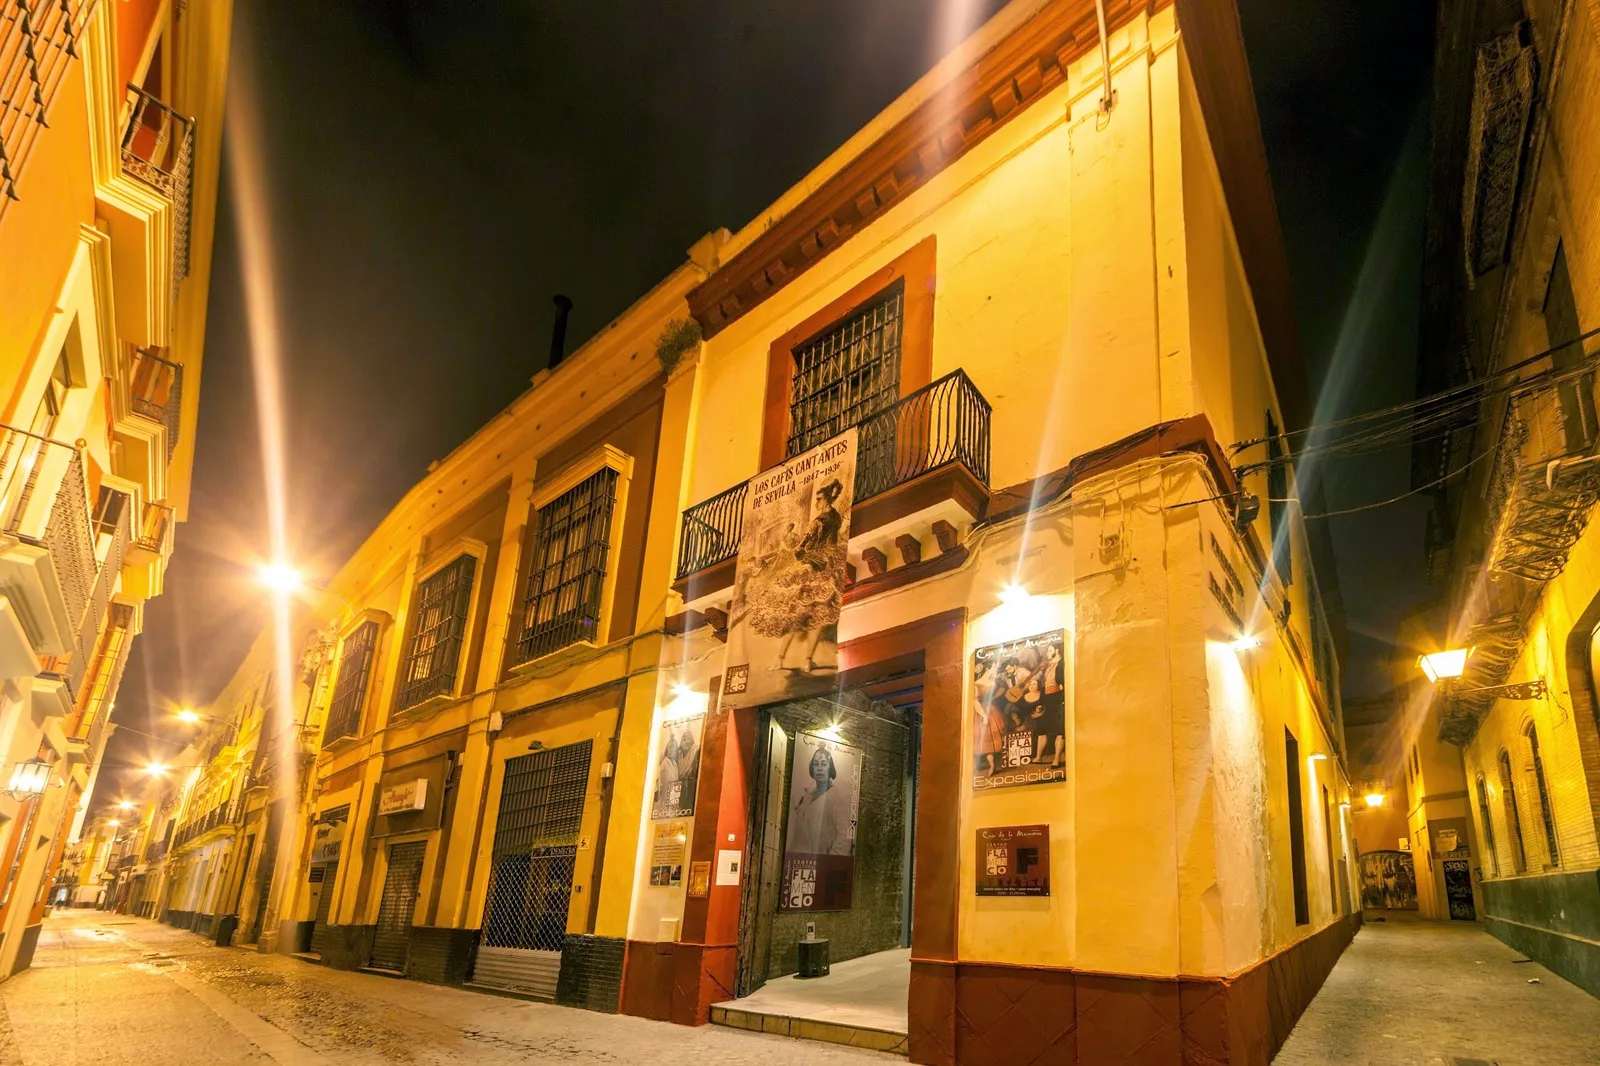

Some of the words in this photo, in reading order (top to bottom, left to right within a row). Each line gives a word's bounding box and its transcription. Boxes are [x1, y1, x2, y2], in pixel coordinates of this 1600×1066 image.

[754, 479, 769, 495] LOS
[795, 439, 847, 475] CANTANTES
[752, 495, 763, 509] DE
[764, 480, 796, 504] SEVILLA
[1009, 739, 1031, 748] FLA
[1010, 747, 1031, 756] MEN
[1009, 756, 1031, 766] CO
[973, 768, 1064, 788] Exposición
[847, 764, 860, 840] Exposición
[652, 808, 692, 819] Exhibition
[987, 849, 1007, 858] FLA
[792, 869, 816, 881] FLA
[987, 866, 1008, 875] CO
[790, 882, 814, 894] MEN
[789, 895, 814, 907] CO
